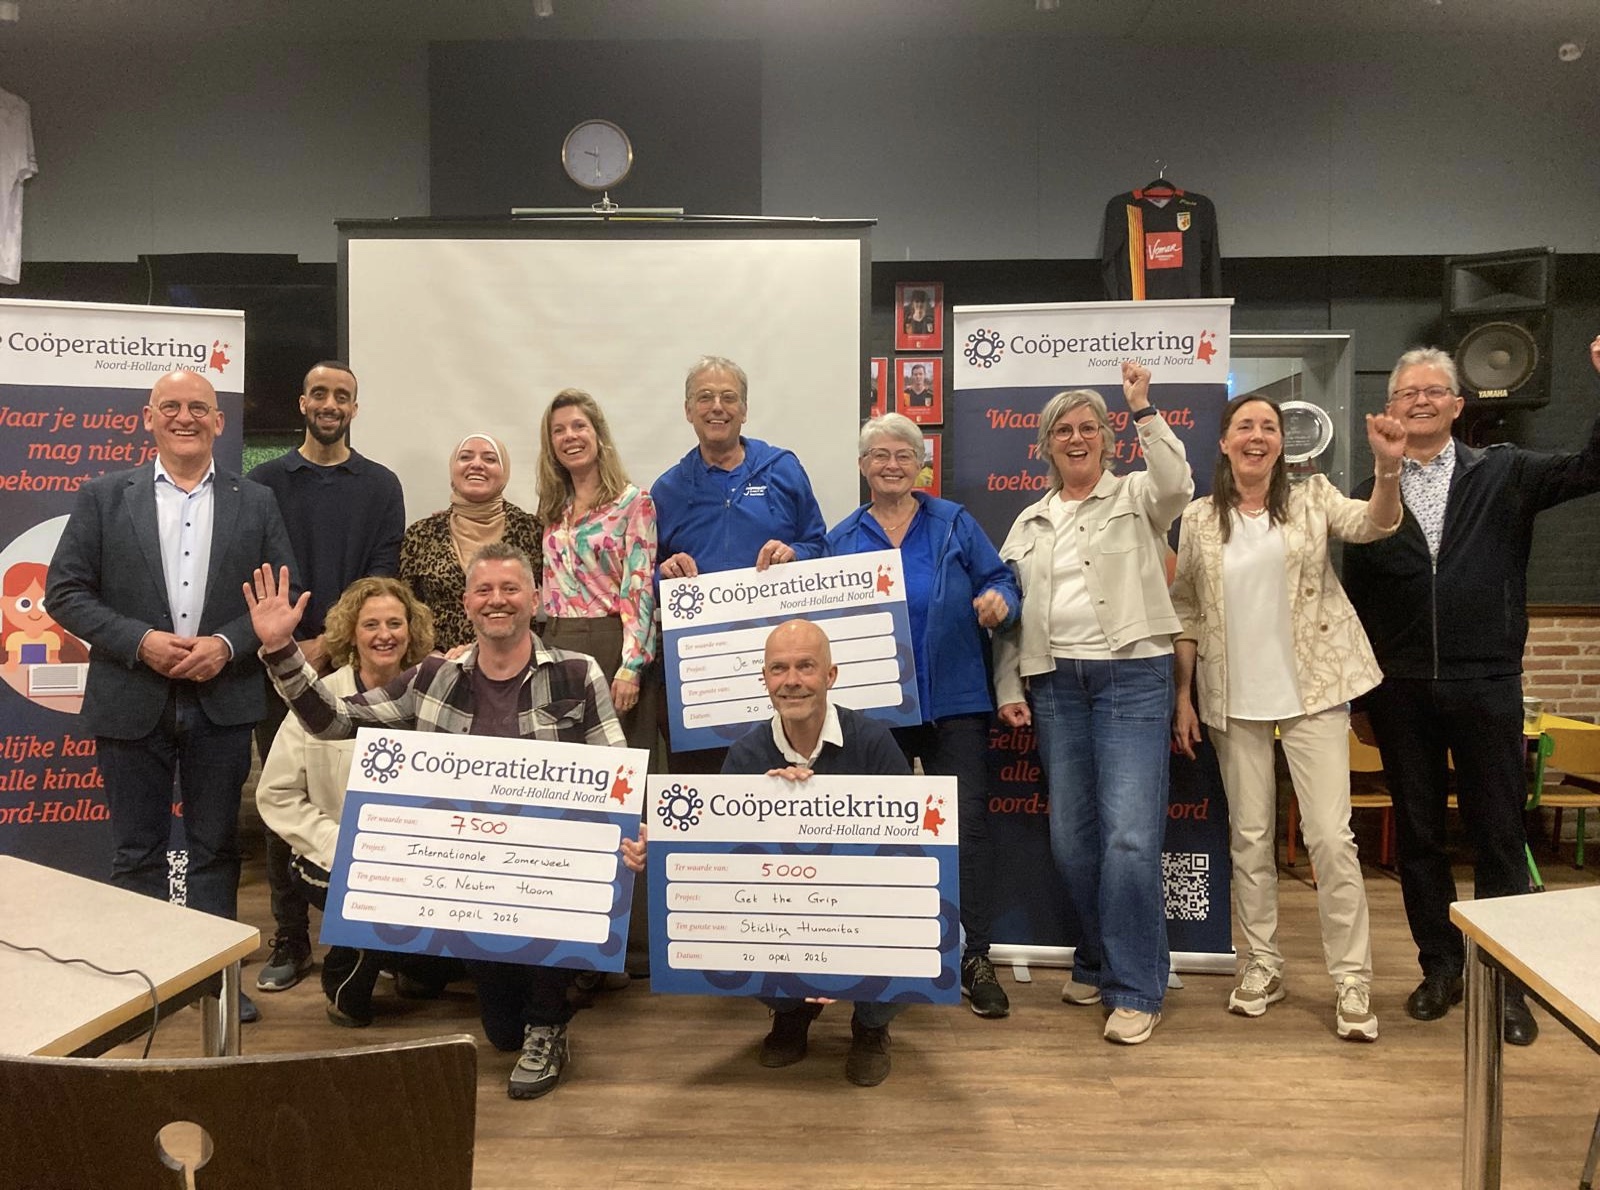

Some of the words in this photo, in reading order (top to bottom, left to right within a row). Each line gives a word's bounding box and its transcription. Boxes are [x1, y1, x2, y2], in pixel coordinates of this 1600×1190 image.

[8, 332, 207, 363] Coöperatiekring
[1010, 331, 1194, 359] Coöperatiekring
[94, 360, 171, 372] Noord-Holland
[1164, 355, 1194, 365] Noord
[1478, 389, 1508, 398] YAMAHA
[50, 407, 76, 432] je
[82, 408, 139, 434] wieg
[1107, 411, 1129, 432] eg
[28, 443, 82, 465] mag
[88, 439, 134, 461] niet
[134, 441, 159, 466] je
[987, 469, 1052, 491] toeko
[709, 570, 873, 604] Coöperatiekring
[780, 595, 844, 610] Noord-Holland
[847, 589, 875, 602] Noord
[733, 656, 748, 671] Je
[746, 705, 759, 713] 20
[0, 734, 56, 763] lijke
[411, 750, 610, 791] Coöperatiekring
[1000, 761, 1041, 782] alle
[490, 785, 570, 801] Noord-Holland
[572, 790, 607, 804] Noord
[709, 793, 920, 823] Coöperatiekring
[451, 815, 507, 835] 7500
[798, 824, 880, 836] Noord-Holland
[883, 824, 920, 837] Noord
[406, 843, 486, 862] Internationale
[761, 863, 817, 879] 5000
[455, 875, 495, 891] Newton
[734, 890, 758, 904] Get
[773, 891, 792, 904] the
[808, 891, 839, 907] Grip
[418, 905, 435, 918] 20
[449, 908, 484, 923] april
[493, 911, 519, 924] 2026
[796, 920, 861, 934] Humanitas
[743, 953, 755, 962] 20
[768, 953, 791, 965] april
[804, 951, 828, 963] 2026
